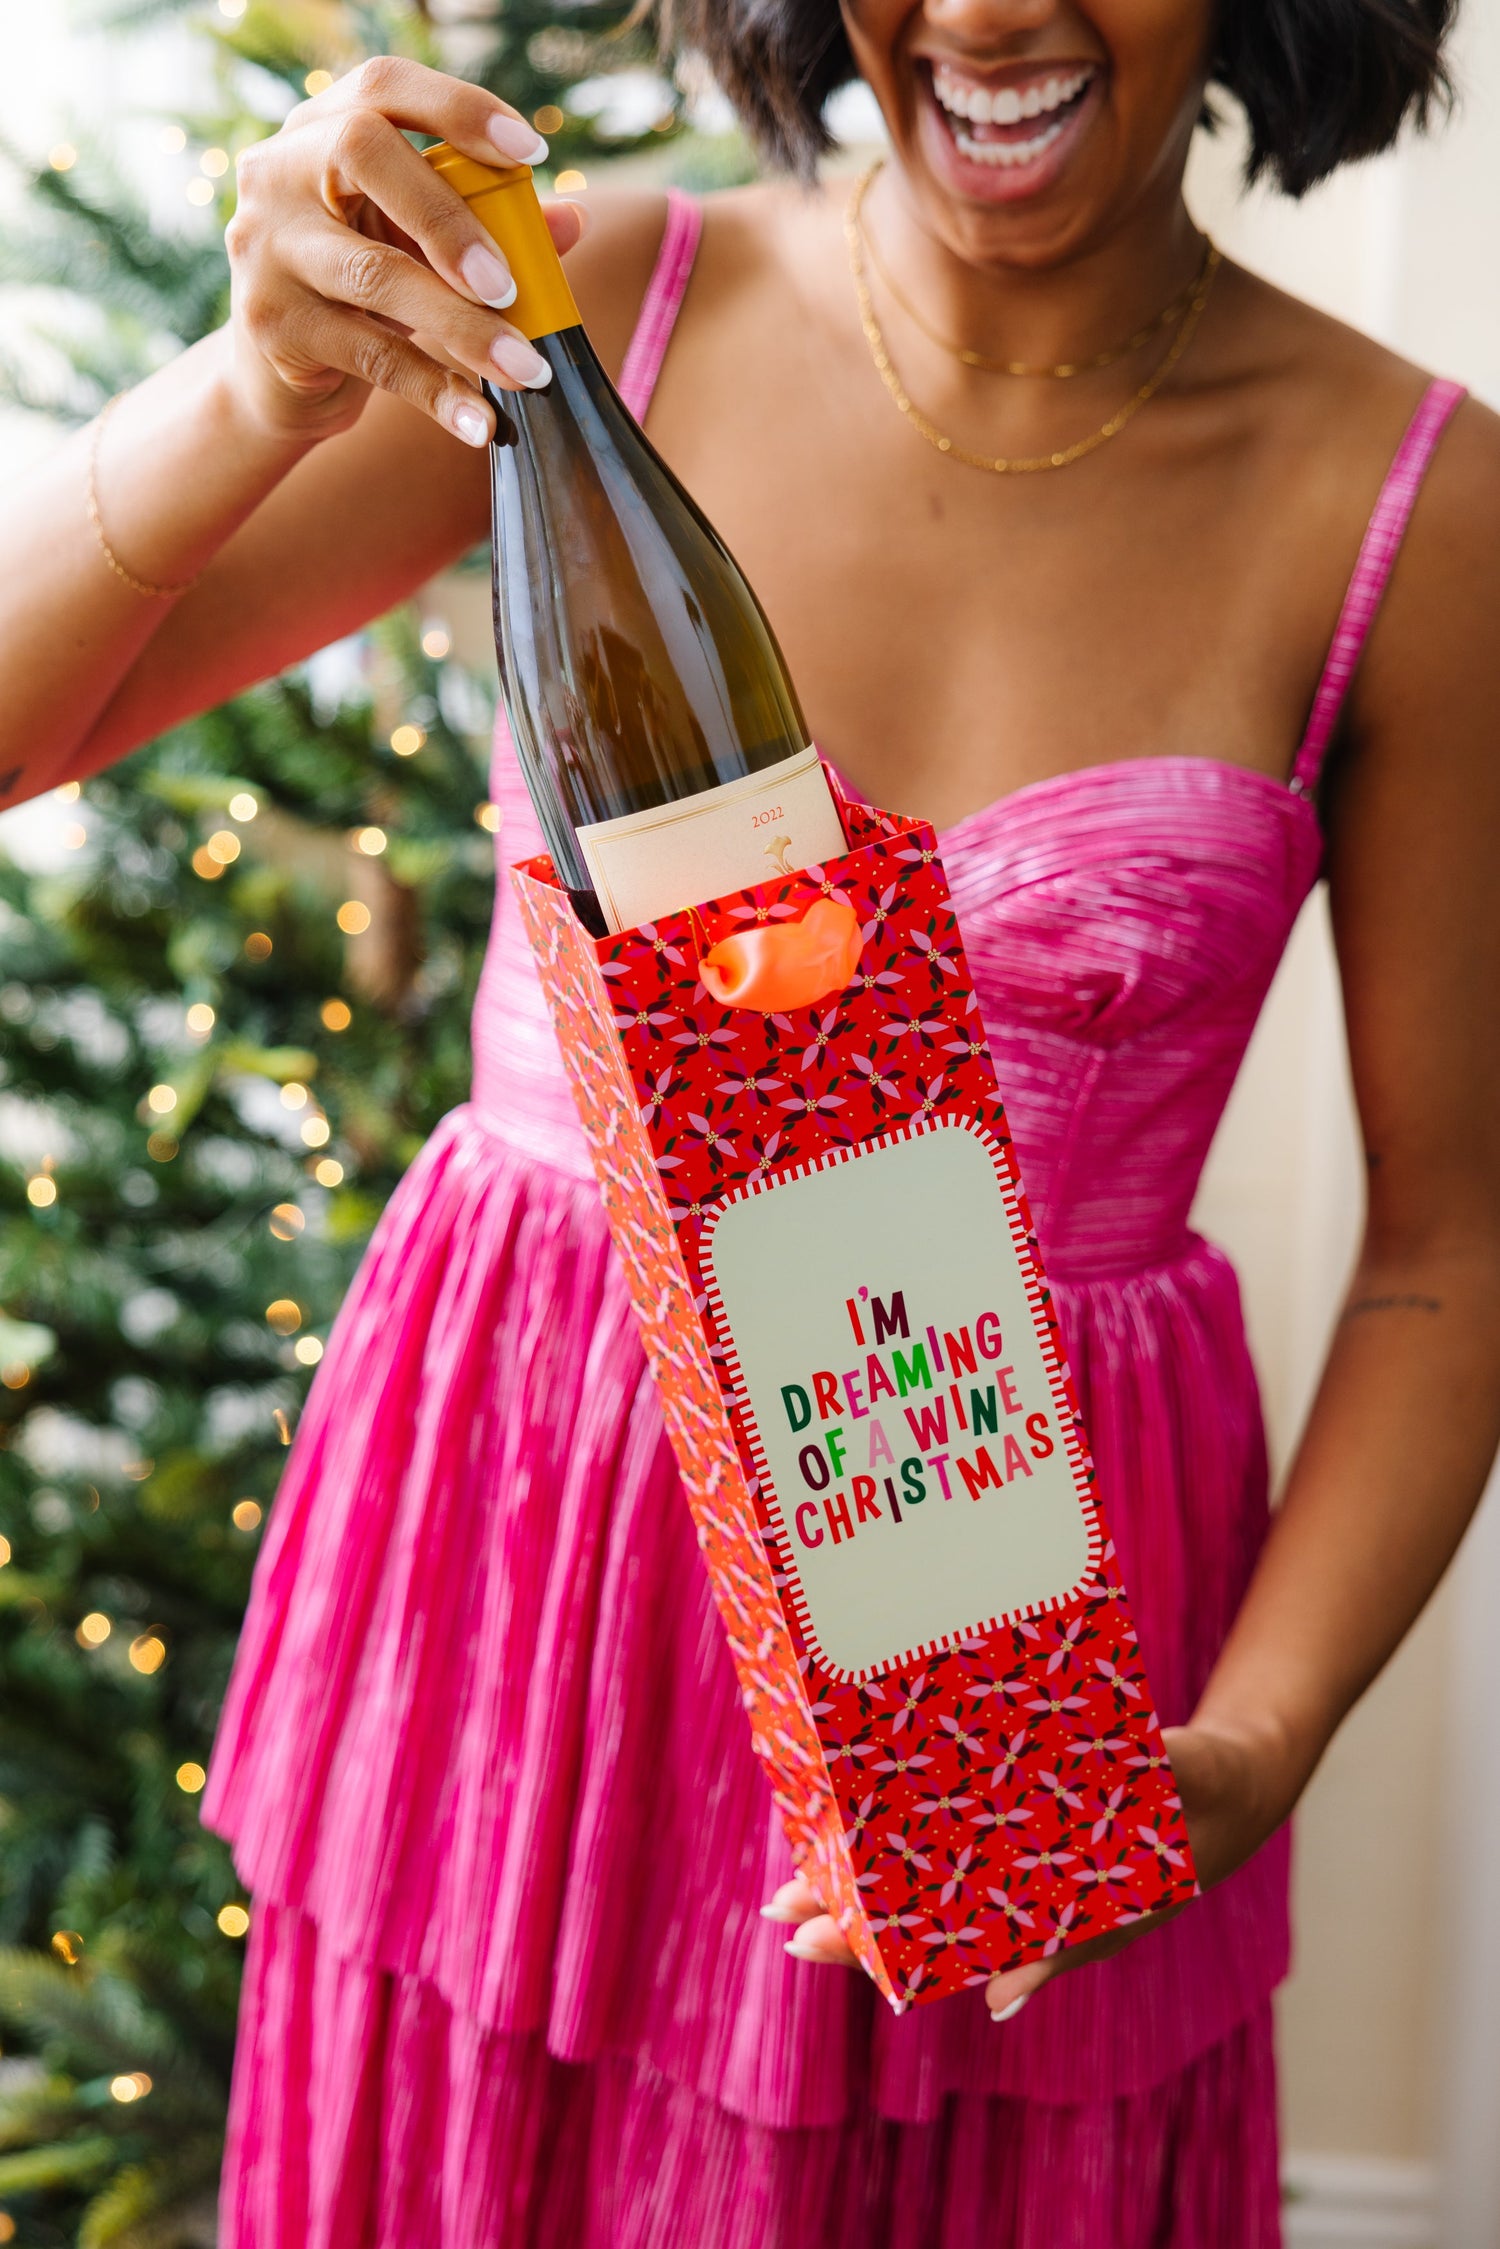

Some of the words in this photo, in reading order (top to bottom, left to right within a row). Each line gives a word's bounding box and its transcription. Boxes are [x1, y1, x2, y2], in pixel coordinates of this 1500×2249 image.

[752, 806, 785, 828] 2022
[781, 1312, 1002, 1433] DREAMING
[846, 1286, 910, 1345] I'M
[795, 1412, 1054, 1549] CHRISTMAS
[798, 1428, 847, 1491] OF
[869, 1419, 896, 1468] A
[904, 1365, 1023, 1453] WINE
